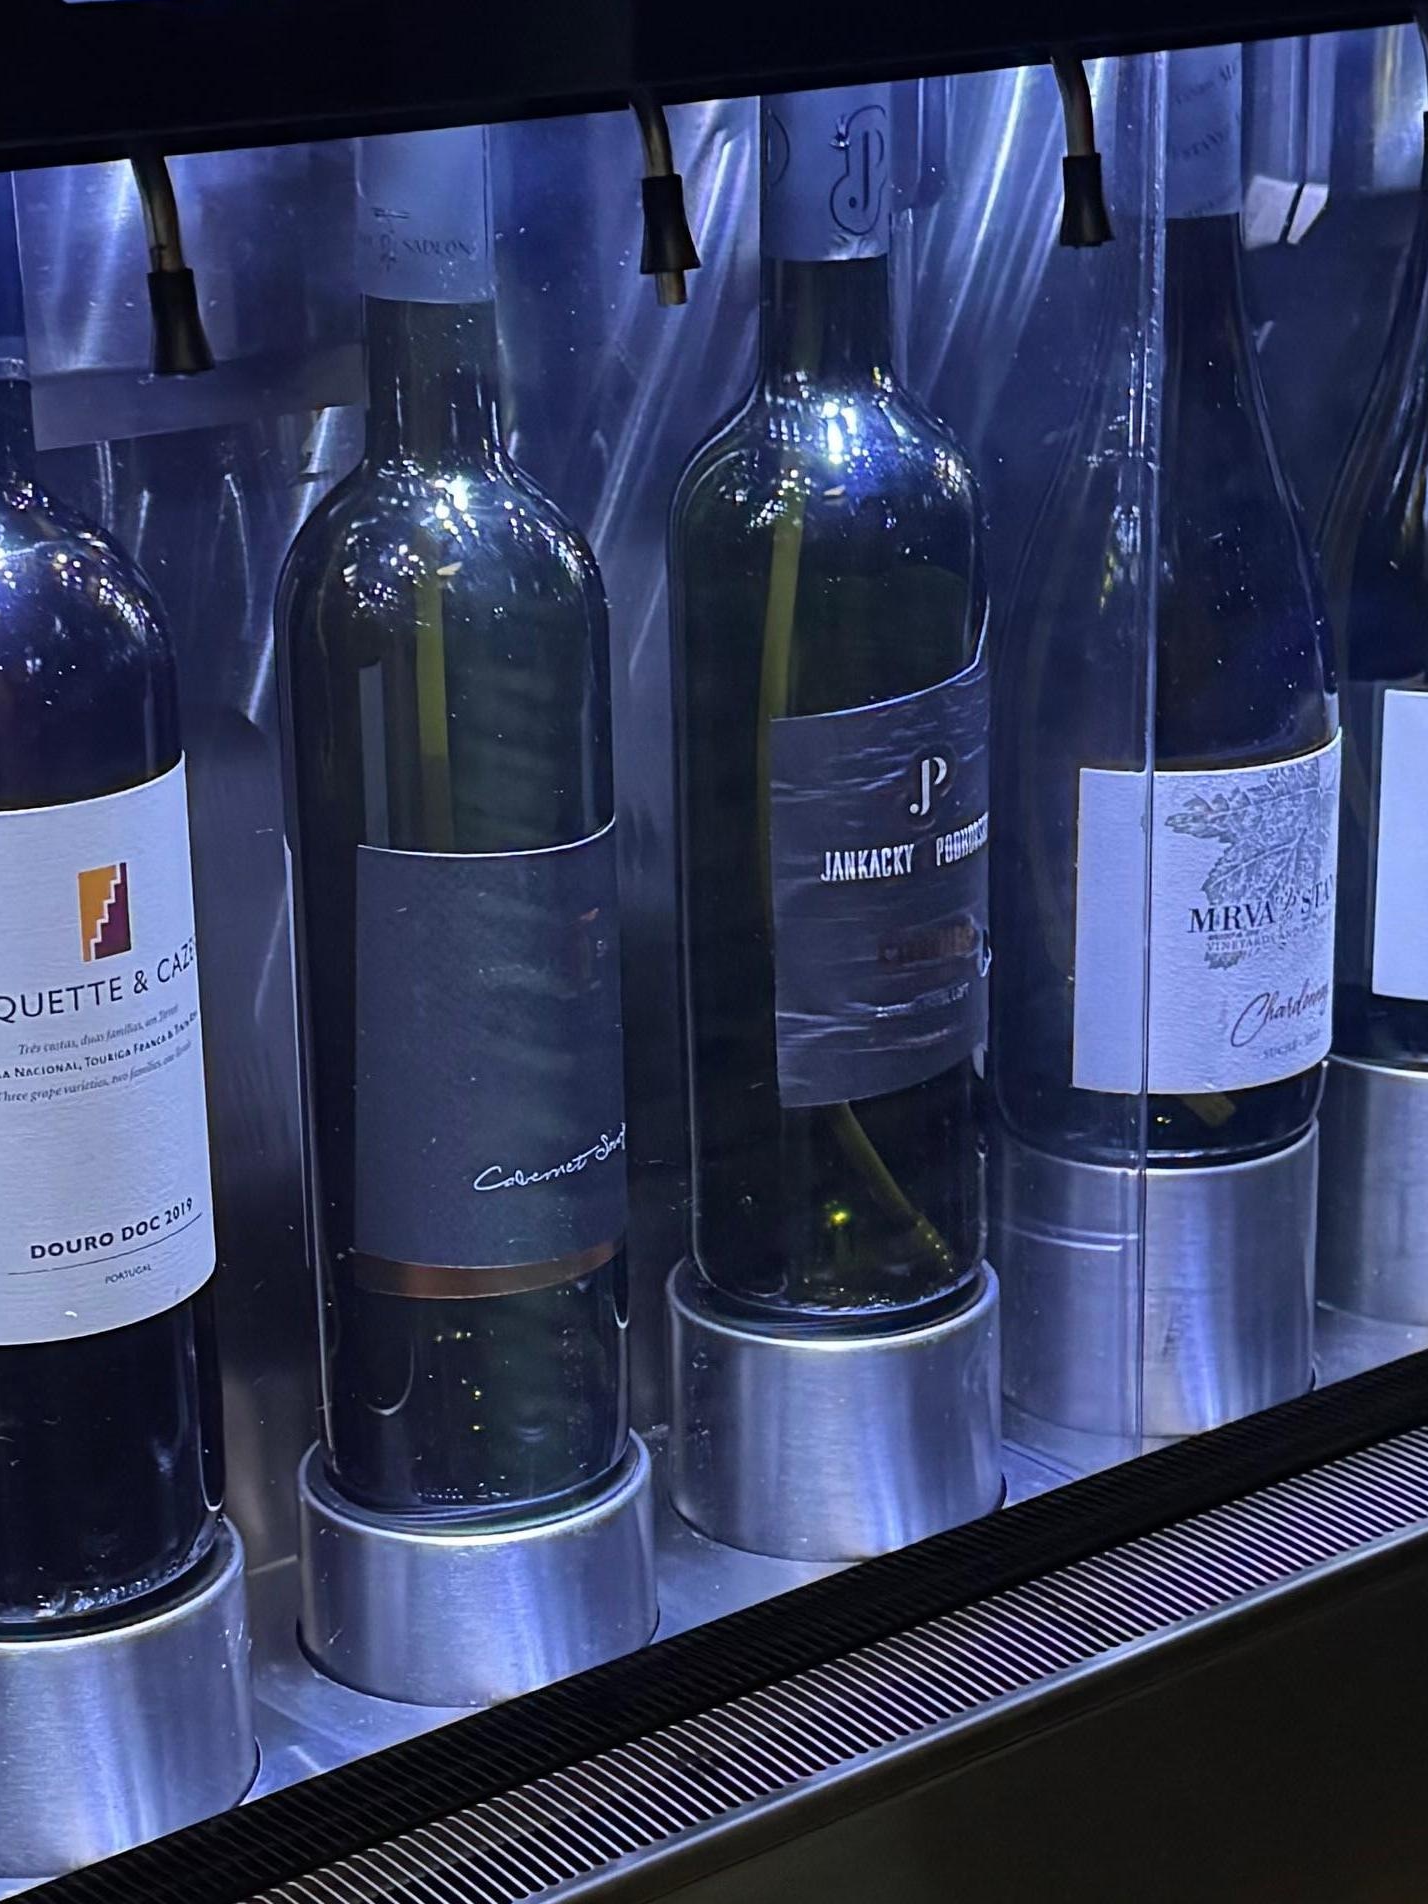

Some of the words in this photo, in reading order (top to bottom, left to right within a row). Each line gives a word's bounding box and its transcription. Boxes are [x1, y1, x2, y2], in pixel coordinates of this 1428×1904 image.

[1187, 900, 1276, 934] MRVA
[133, 970, 149, 994] &
[30, 1088, 62, 1103] grape
[473, 1145, 599, 1191] Cabernet
[31, 1231, 113, 1260] DOURO
[122, 1215, 161, 1243] DOC
[164, 1197, 193, 1226] 2019
[105, 1264, 152, 1284] PORTUGAL
